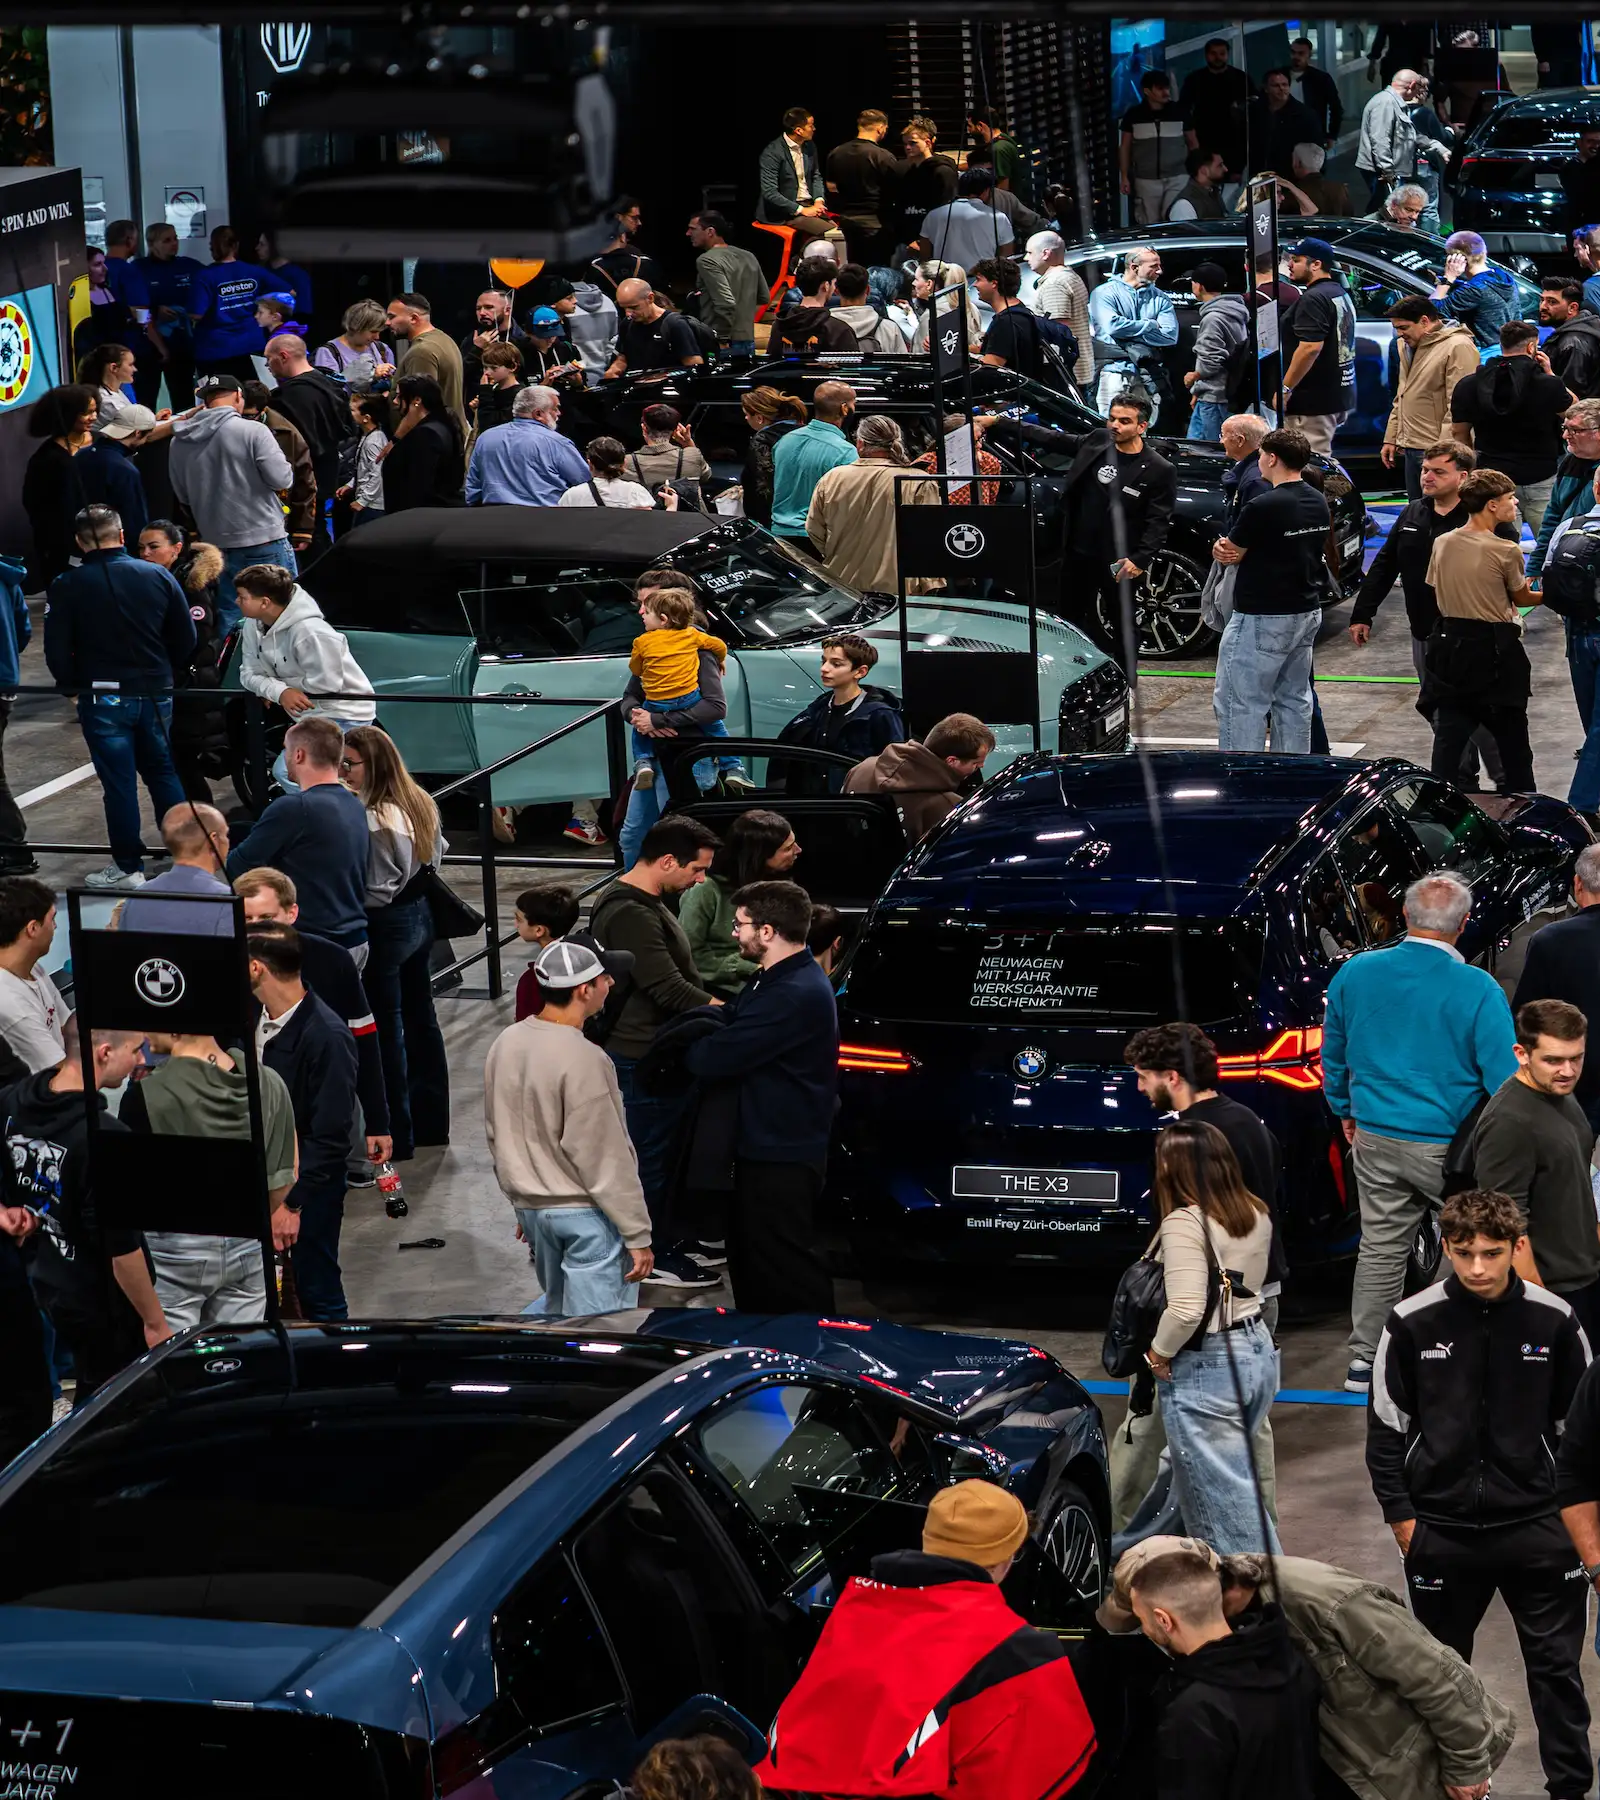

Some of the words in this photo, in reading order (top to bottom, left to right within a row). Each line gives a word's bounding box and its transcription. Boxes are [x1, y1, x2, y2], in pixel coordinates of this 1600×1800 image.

[1, 213, 24, 234] SPIN
[26, 207, 48, 228] AND
[48, 202, 72, 220] WIN.
[706, 575, 729, 589] CHF
[140, 961, 178, 975] BMW
[979, 957, 1064, 969] NEUWAGEN
[976, 970, 1003, 980] MIT
[1005, 971, 1011, 980] 1
[1012, 971, 1051, 981] JAHR
[973, 983, 1099, 997] WERKSGARANTIE
[1000, 1174, 1040, 1192] THE
[1045, 1176, 1069, 1192] X3
[966, 1218, 992, 1228] Emil
[995, 1219, 1020, 1231] Frey
[1022, 1220, 1100, 1232] Züri-Oberland
[1421, 1350, 1447, 1360] PUMA
[1564, 1567, 1583, 1580] PUM
[56, 1718, 74, 1755] 1
[0, 1761, 78, 1784] WAGEN
